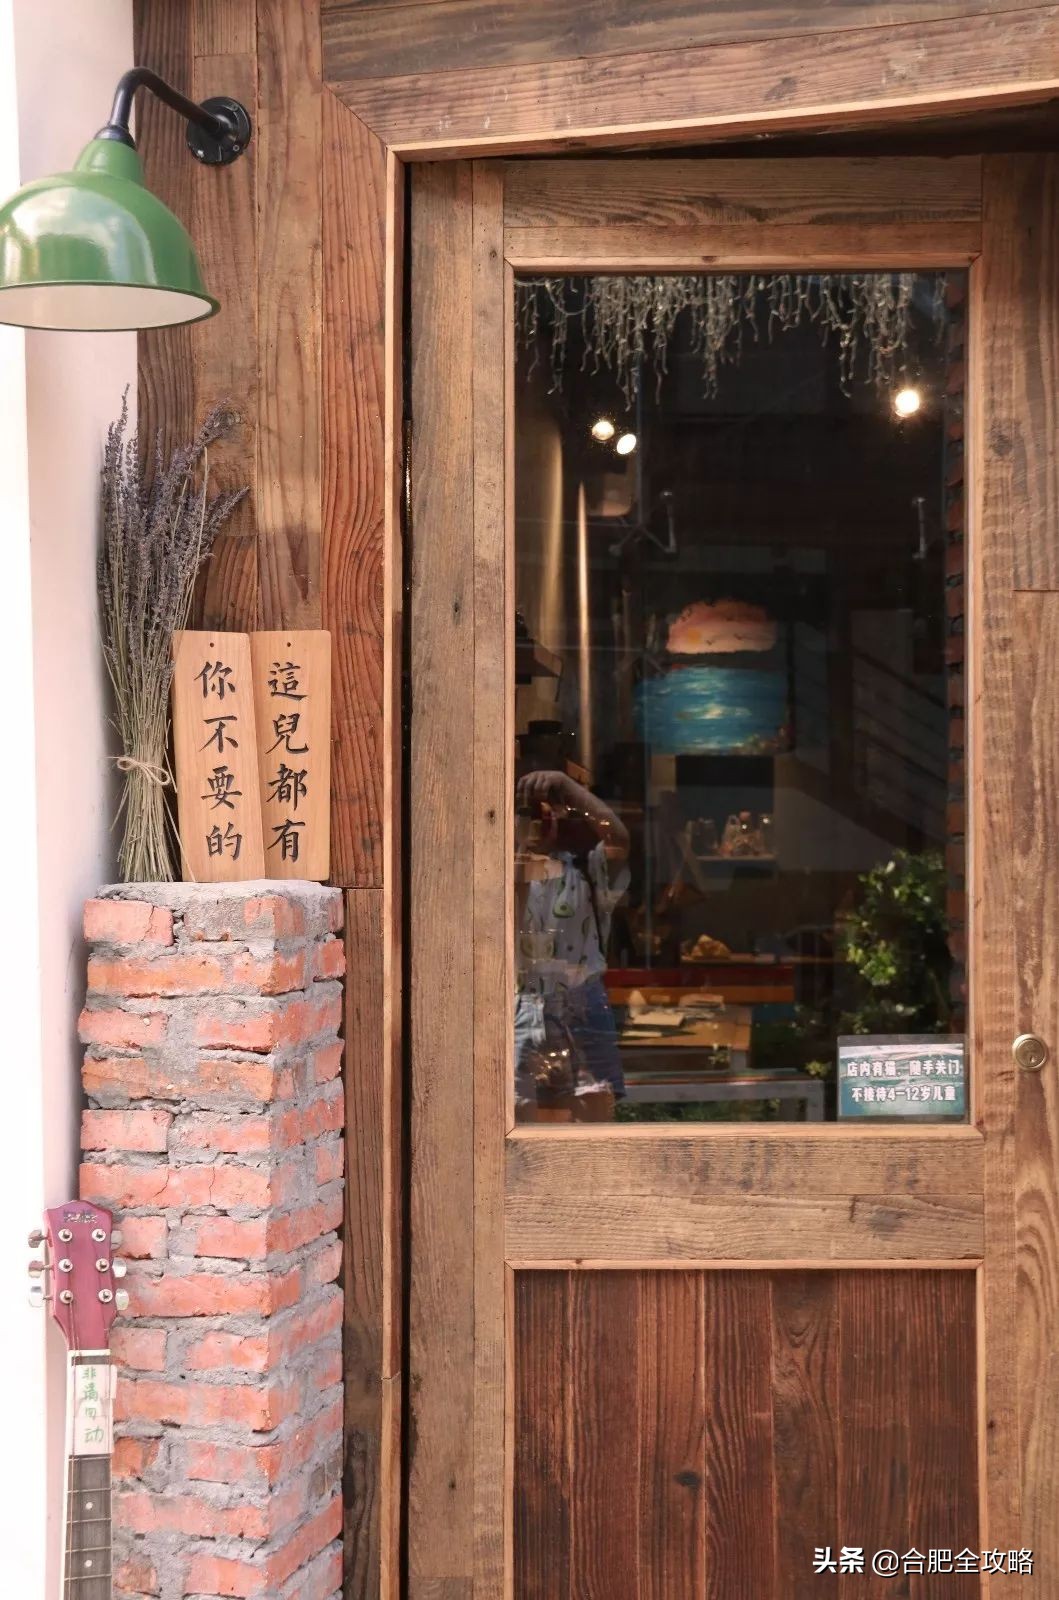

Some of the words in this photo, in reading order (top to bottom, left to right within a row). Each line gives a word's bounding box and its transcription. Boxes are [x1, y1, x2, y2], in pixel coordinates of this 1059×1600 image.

[193, 660, 243, 862] 你不要的
[265, 661, 310, 863] 這兒都有
